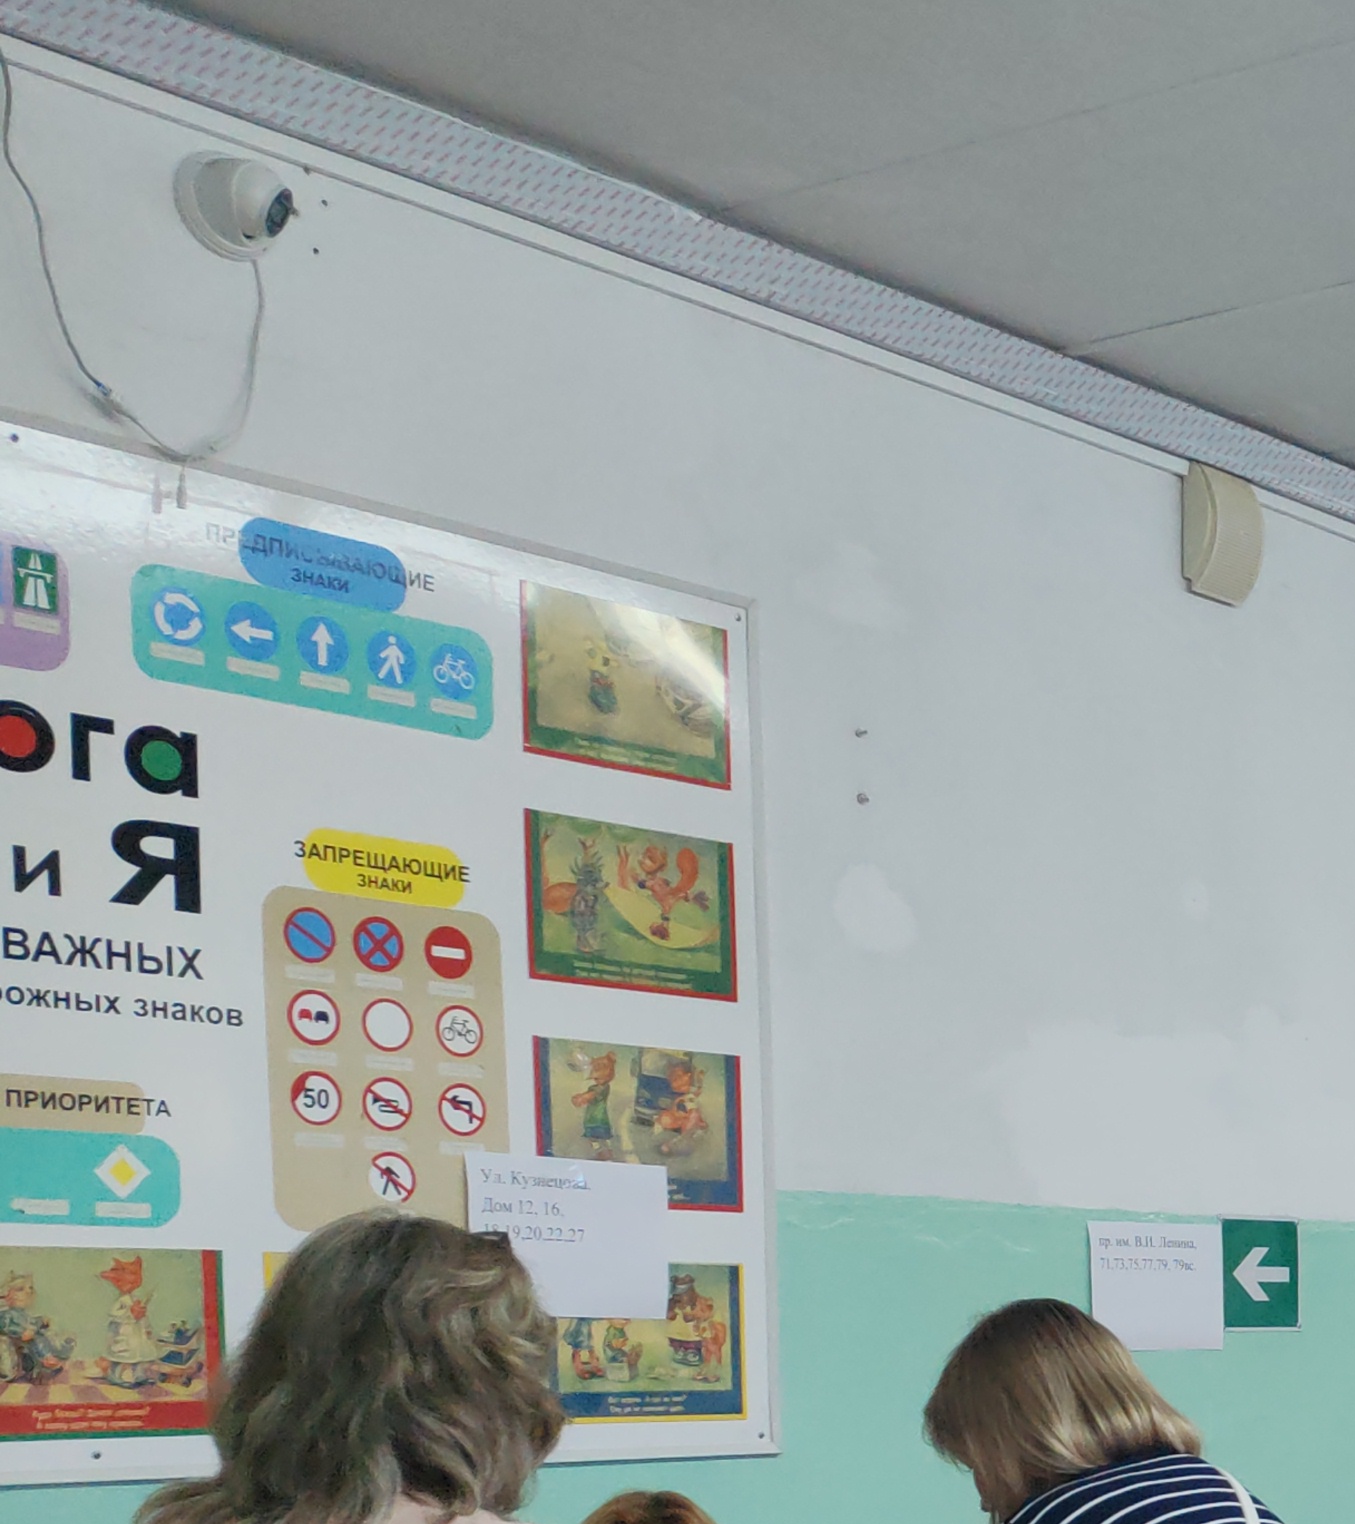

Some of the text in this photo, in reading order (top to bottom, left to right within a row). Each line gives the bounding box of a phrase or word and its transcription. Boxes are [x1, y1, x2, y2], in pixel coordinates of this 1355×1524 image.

[290, 567, 350, 594] ЗНАКИ
[12, 819, 202, 914] и Я
[293, 840, 471, 883] ЗАПРЕЩАЮЩИЕ
[357, 873, 413, 894] ЗНАКИ
[2, 926, 204, 980] ВАЖНЫХ
[0, 984, 245, 1027] ожных знаков
[5, 1088, 173, 1118] ПРИОРИТЕТА
[303, 1088, 329, 1109] 50
[480, 1168, 507, 1184] Ул.
[481, 1197, 513, 1213] Дом
